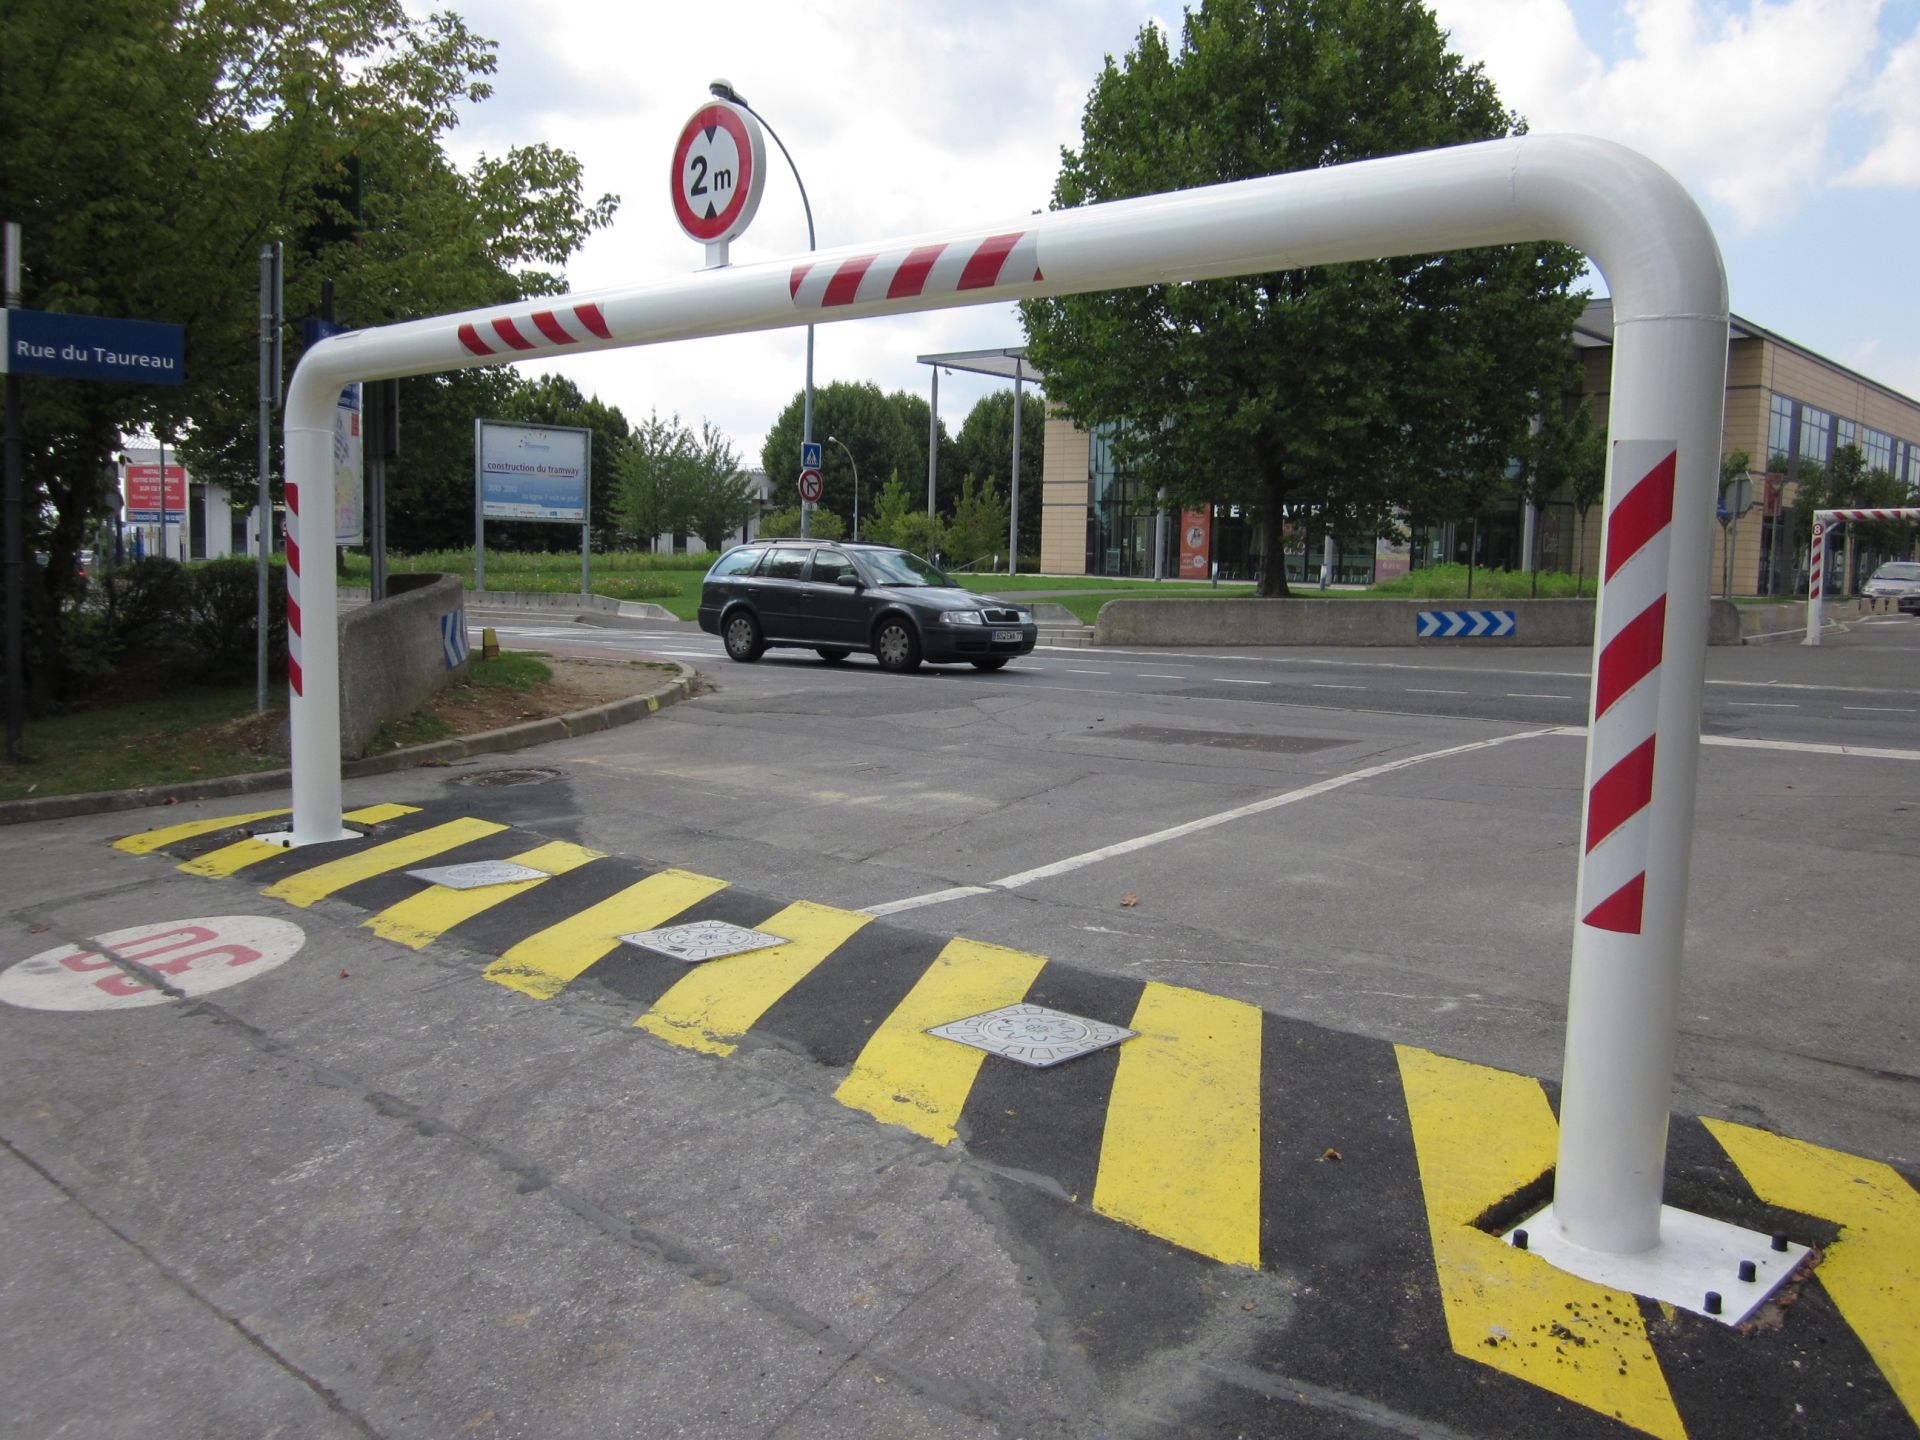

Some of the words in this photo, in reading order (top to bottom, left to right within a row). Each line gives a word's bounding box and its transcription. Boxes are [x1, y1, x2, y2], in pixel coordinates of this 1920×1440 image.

[690, 155, 708, 197] 2
[714, 168, 732, 192] m
[16, 340, 56, 359] Rue
[62, 344, 88, 361] du
[93, 347, 175, 369] Taureau
[487, 462, 535, 473] construction
[536, 464, 546, 473] du
[548, 465, 579, 476] tramway
[58, 926, 263, 996] 30
